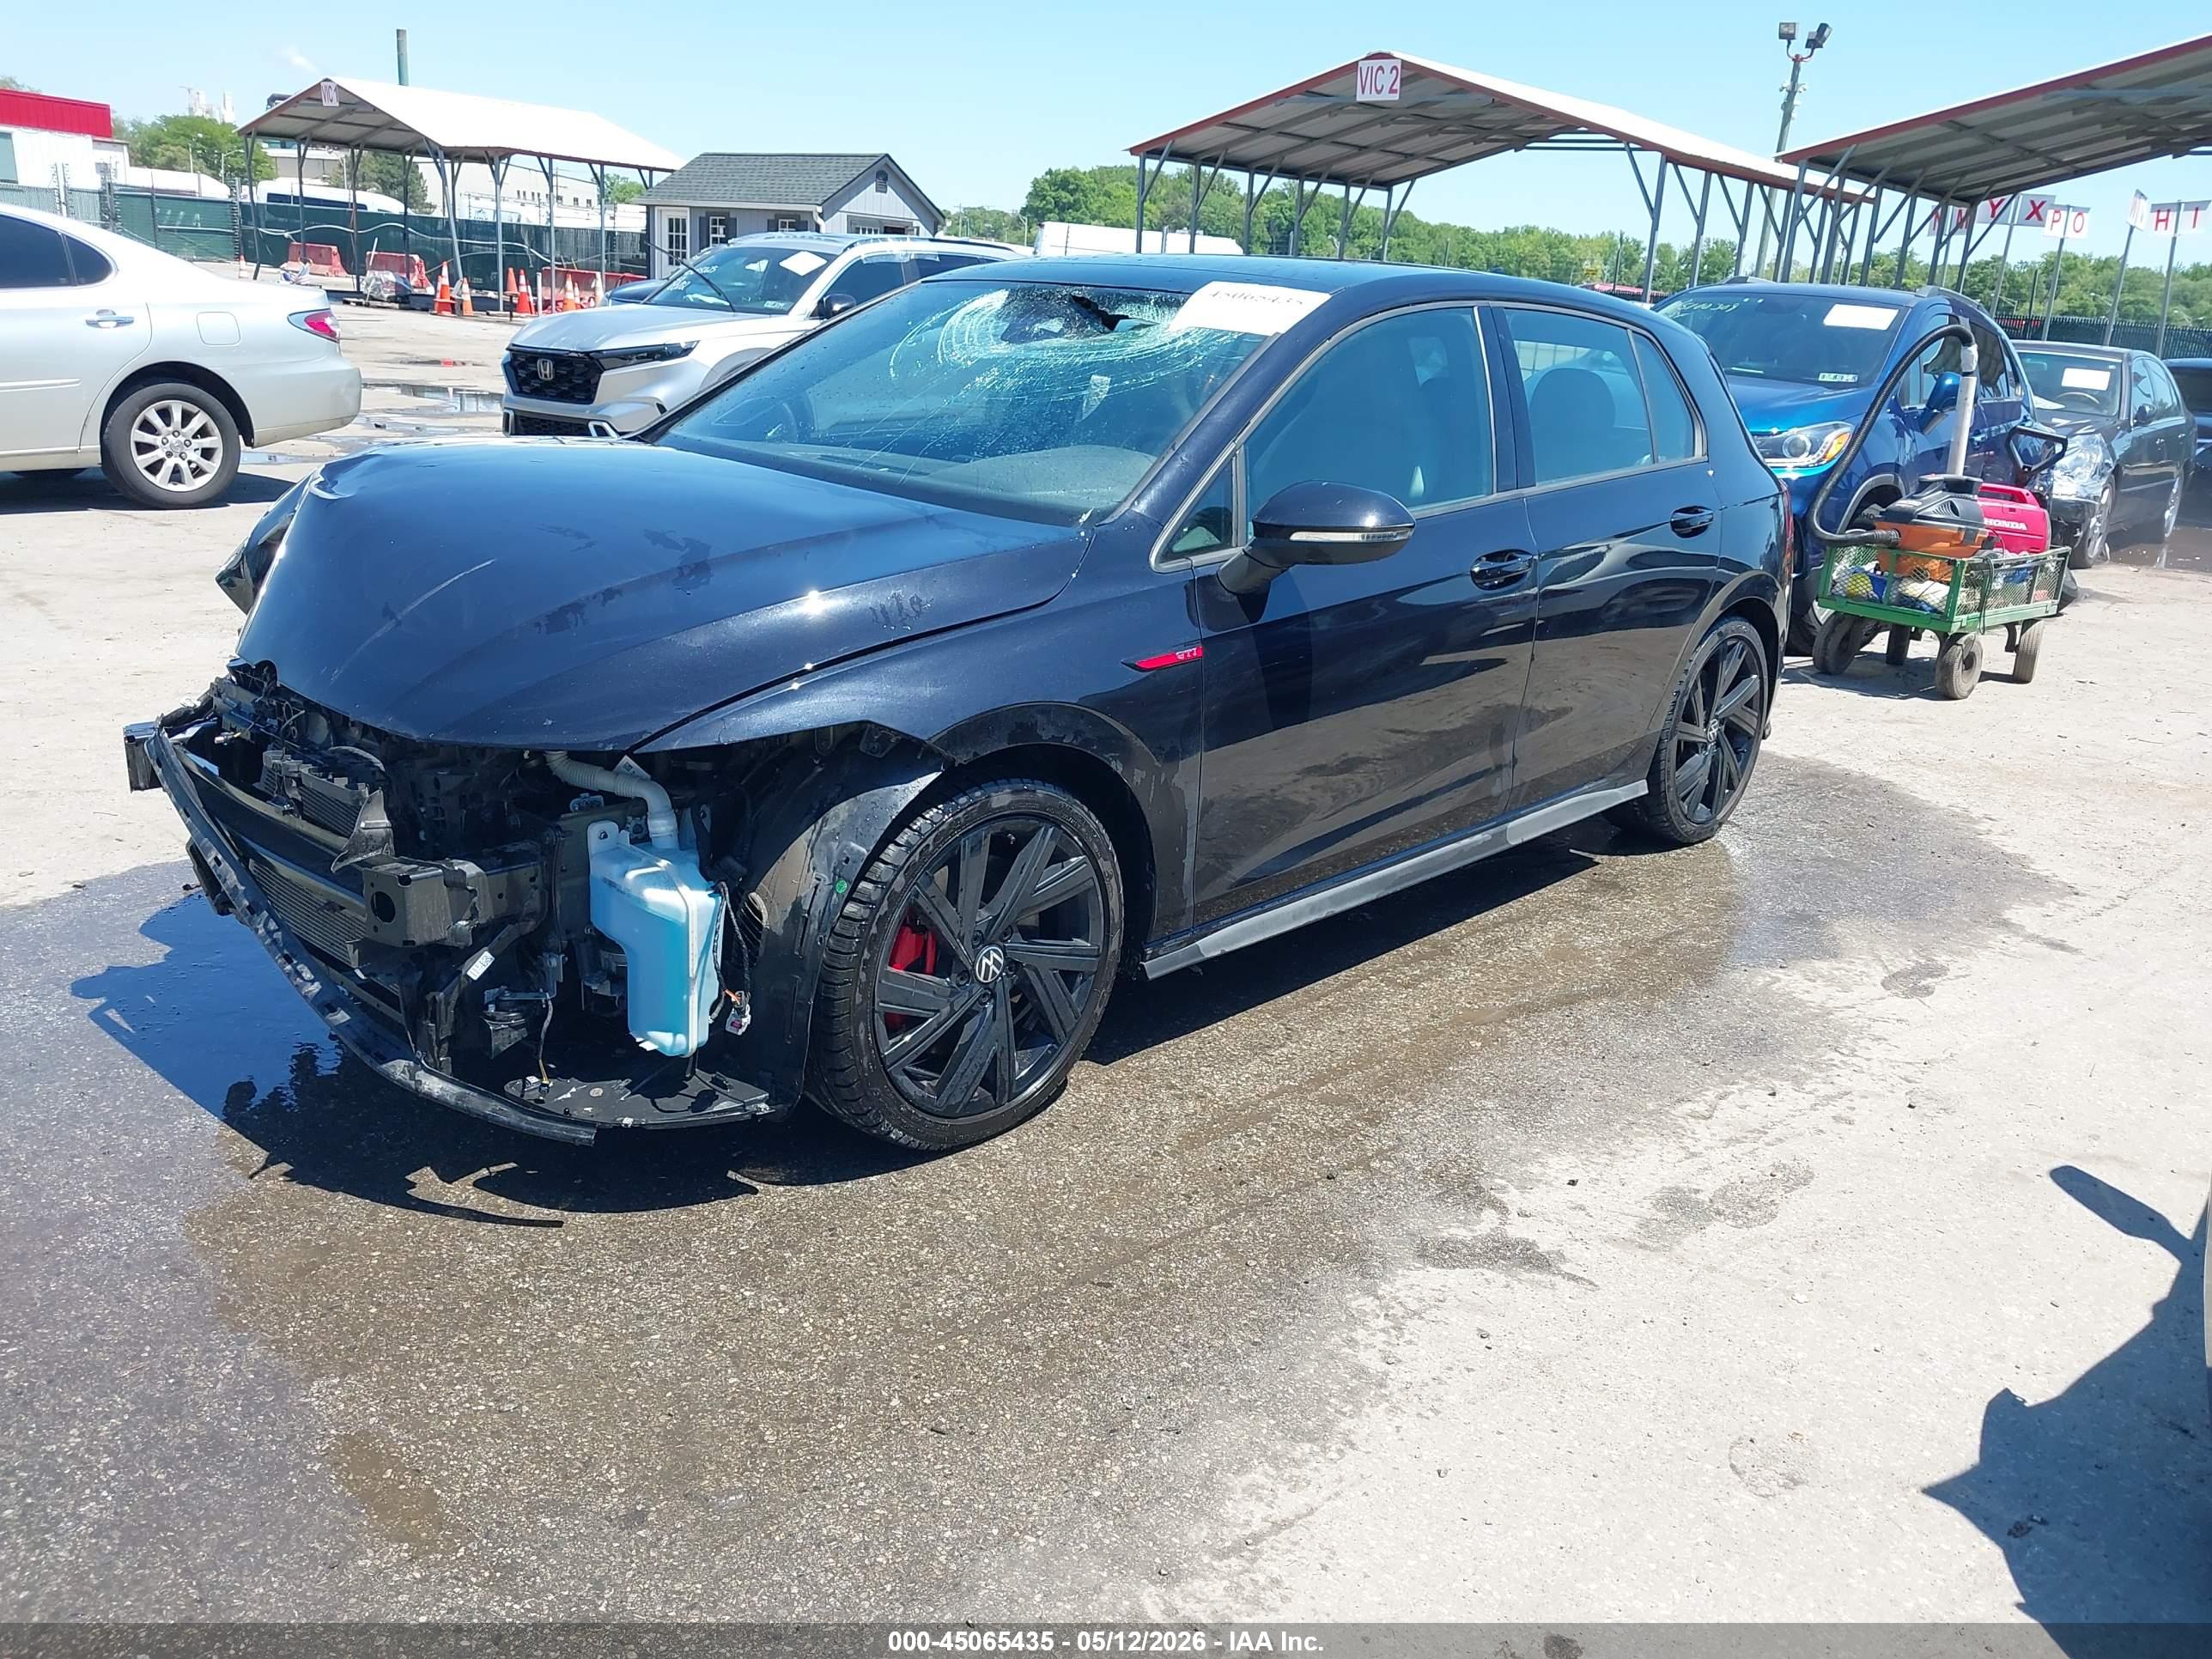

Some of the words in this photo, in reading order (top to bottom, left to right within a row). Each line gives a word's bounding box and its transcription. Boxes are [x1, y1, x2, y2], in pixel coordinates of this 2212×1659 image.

[1359, 65, 1384, 94] VIC
[1389, 64, 1399, 94] 2
[1988, 198, 2006, 218] Y
[2025, 199, 2046, 221] X
[2154, 209, 2171, 231] H
[2050, 210, 2062, 231] P
[2073, 211, 2085, 233] O
[1984, 518, 2027, 531] HONDA
